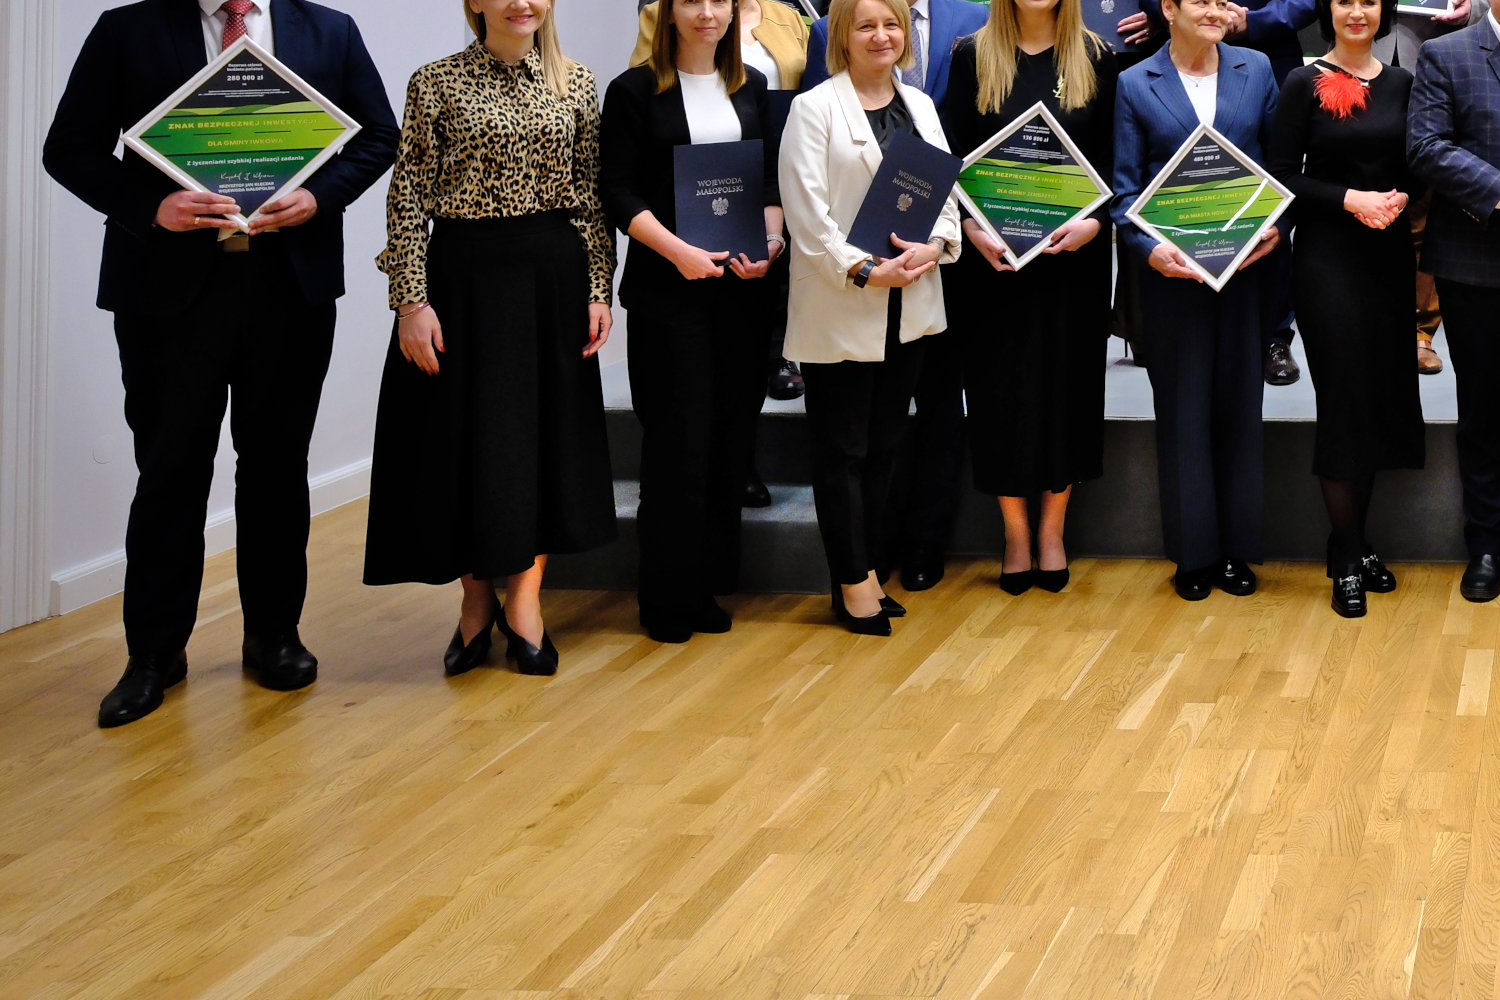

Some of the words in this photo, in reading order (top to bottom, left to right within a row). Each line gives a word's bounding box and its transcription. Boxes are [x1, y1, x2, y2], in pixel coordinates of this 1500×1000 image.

[168, 122, 194, 130] ZNAK
[197, 120, 260, 129] BEZPIECZNEJ
[697, 177, 742, 188] WOJEWODA
